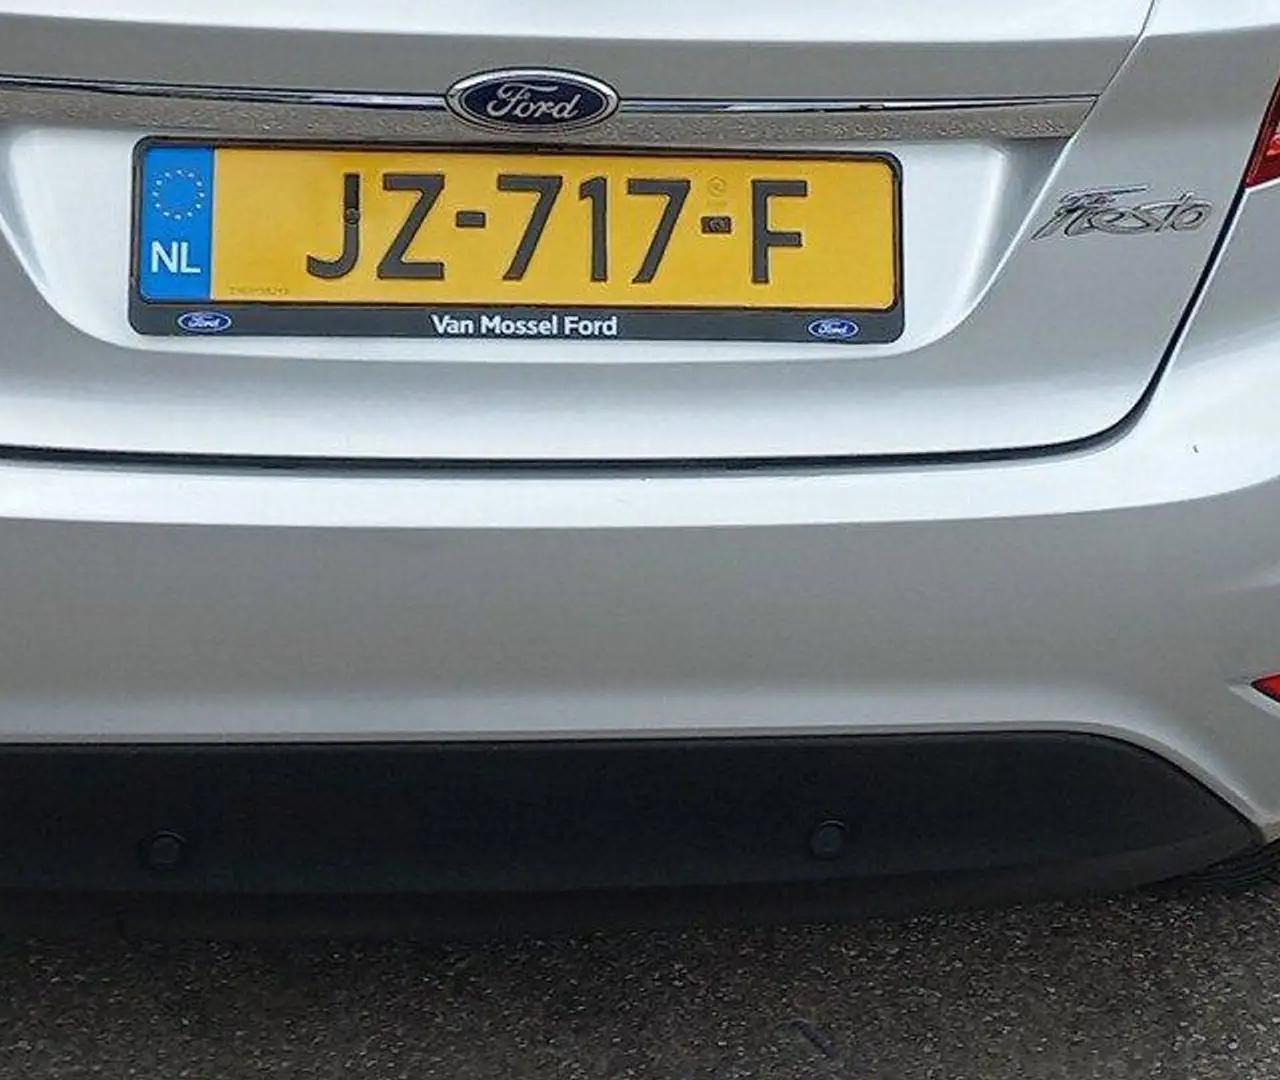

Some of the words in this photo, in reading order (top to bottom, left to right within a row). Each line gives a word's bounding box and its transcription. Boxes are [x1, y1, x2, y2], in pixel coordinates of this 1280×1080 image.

[486, 81, 582, 119] Ford
[305, 172, 808, 285] JZ-717-F
[1030, 183, 1213, 241] Fiesta
[150, 241, 202, 274] NL
[431, 315, 474, 335] Van
[480, 315, 558, 336] Mossel
[564, 316, 618, 336] Ford
